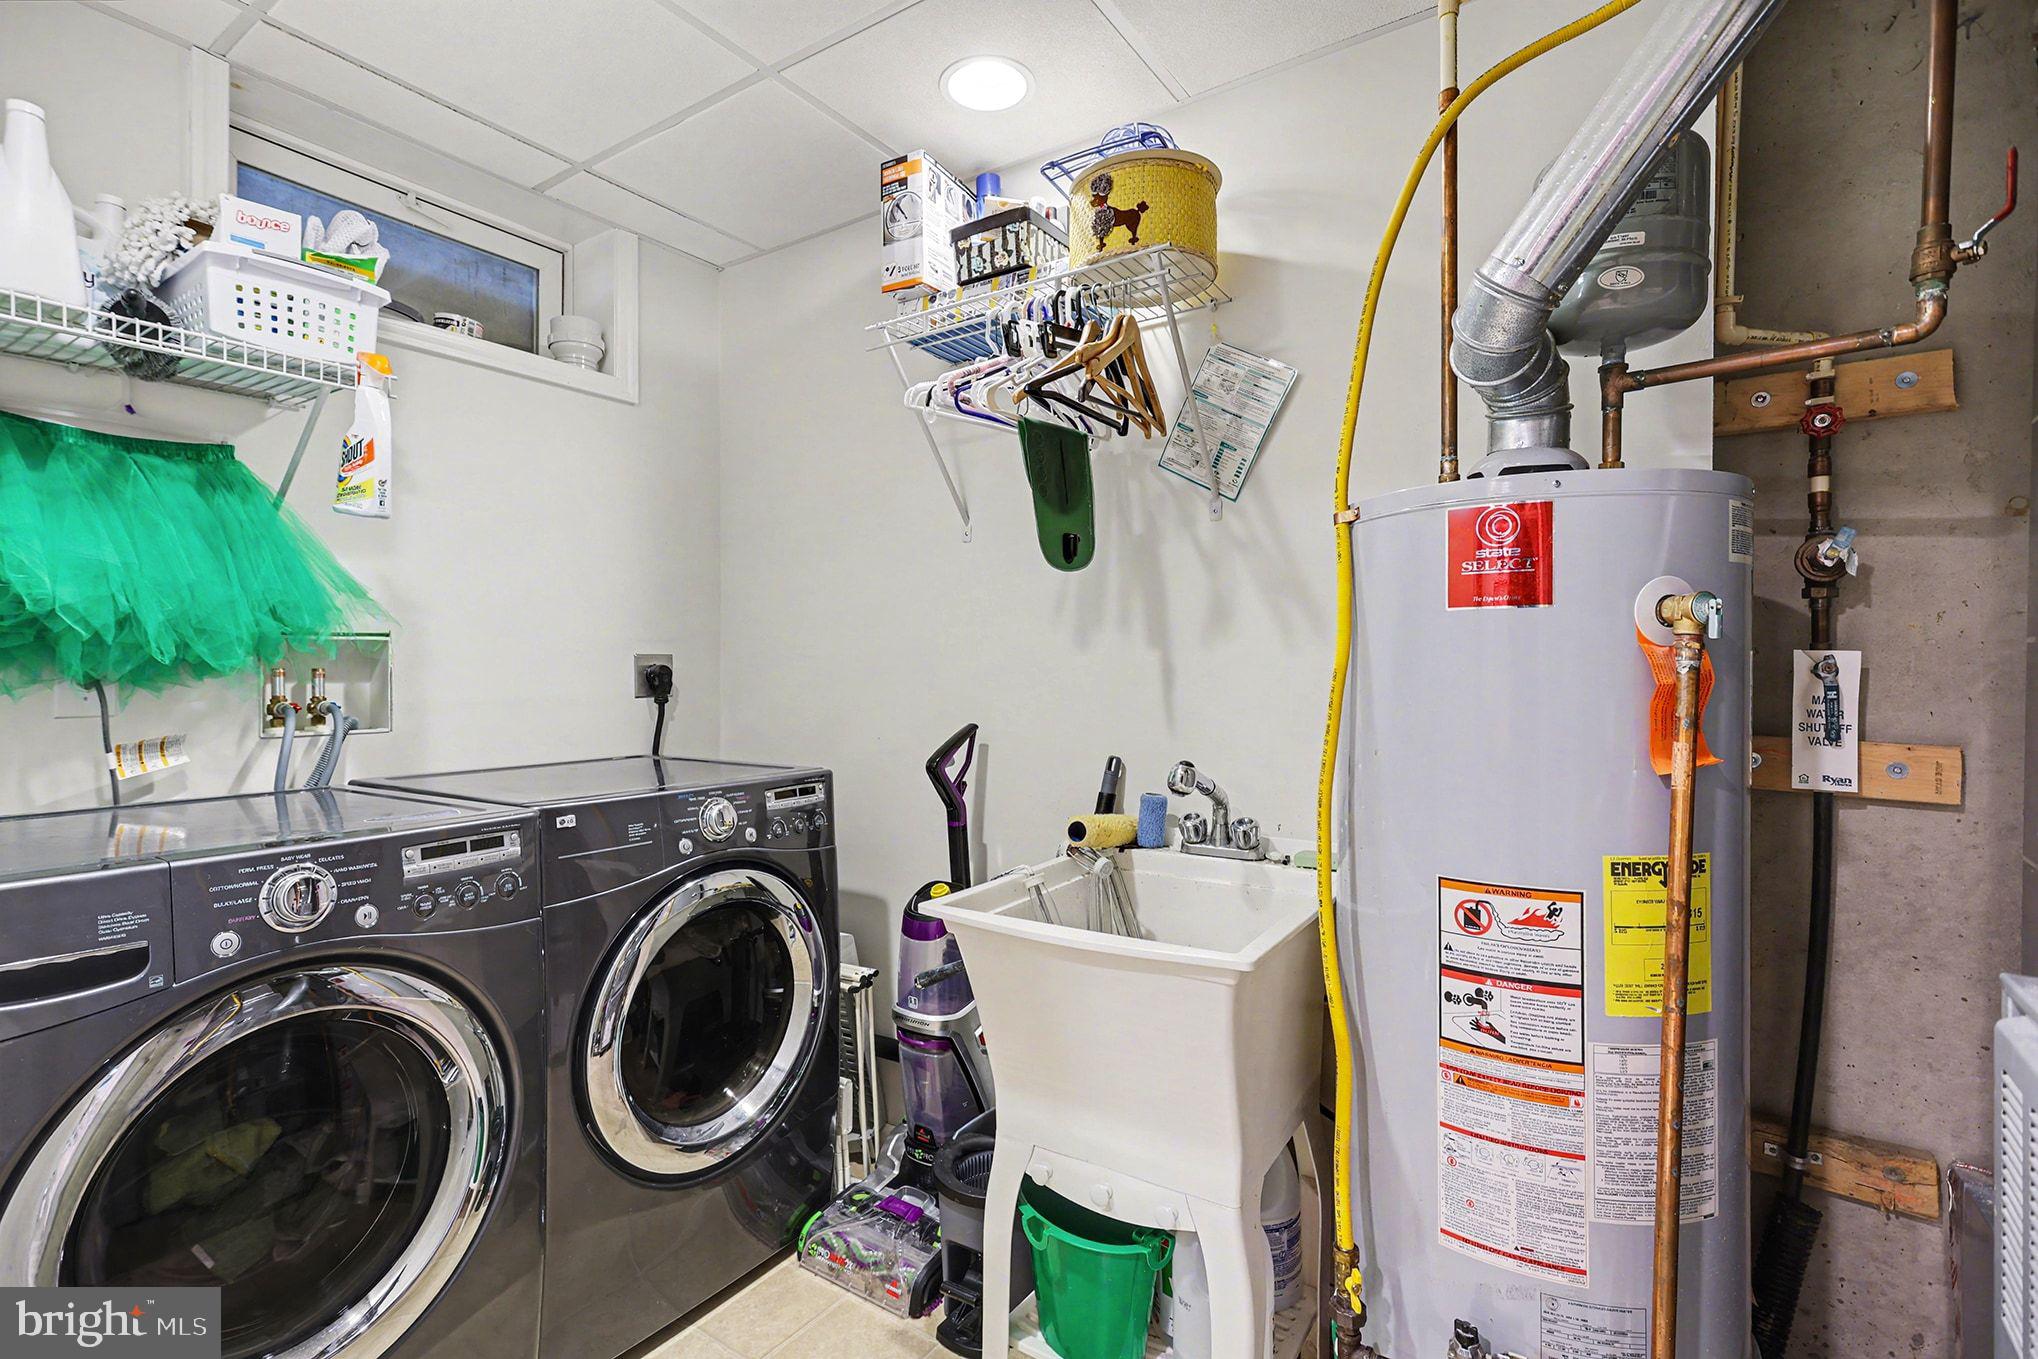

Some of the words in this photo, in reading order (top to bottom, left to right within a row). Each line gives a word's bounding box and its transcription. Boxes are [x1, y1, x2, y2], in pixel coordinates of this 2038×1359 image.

[236, 210, 290, 232] bounce
[1476, 547, 1521, 558] state
[1461, 558, 1533, 571] SELECT
[1822, 775, 1852, 787] Ryan
[1492, 887, 1532, 899] WARNING
[1496, 979, 1533, 992] DANGER
